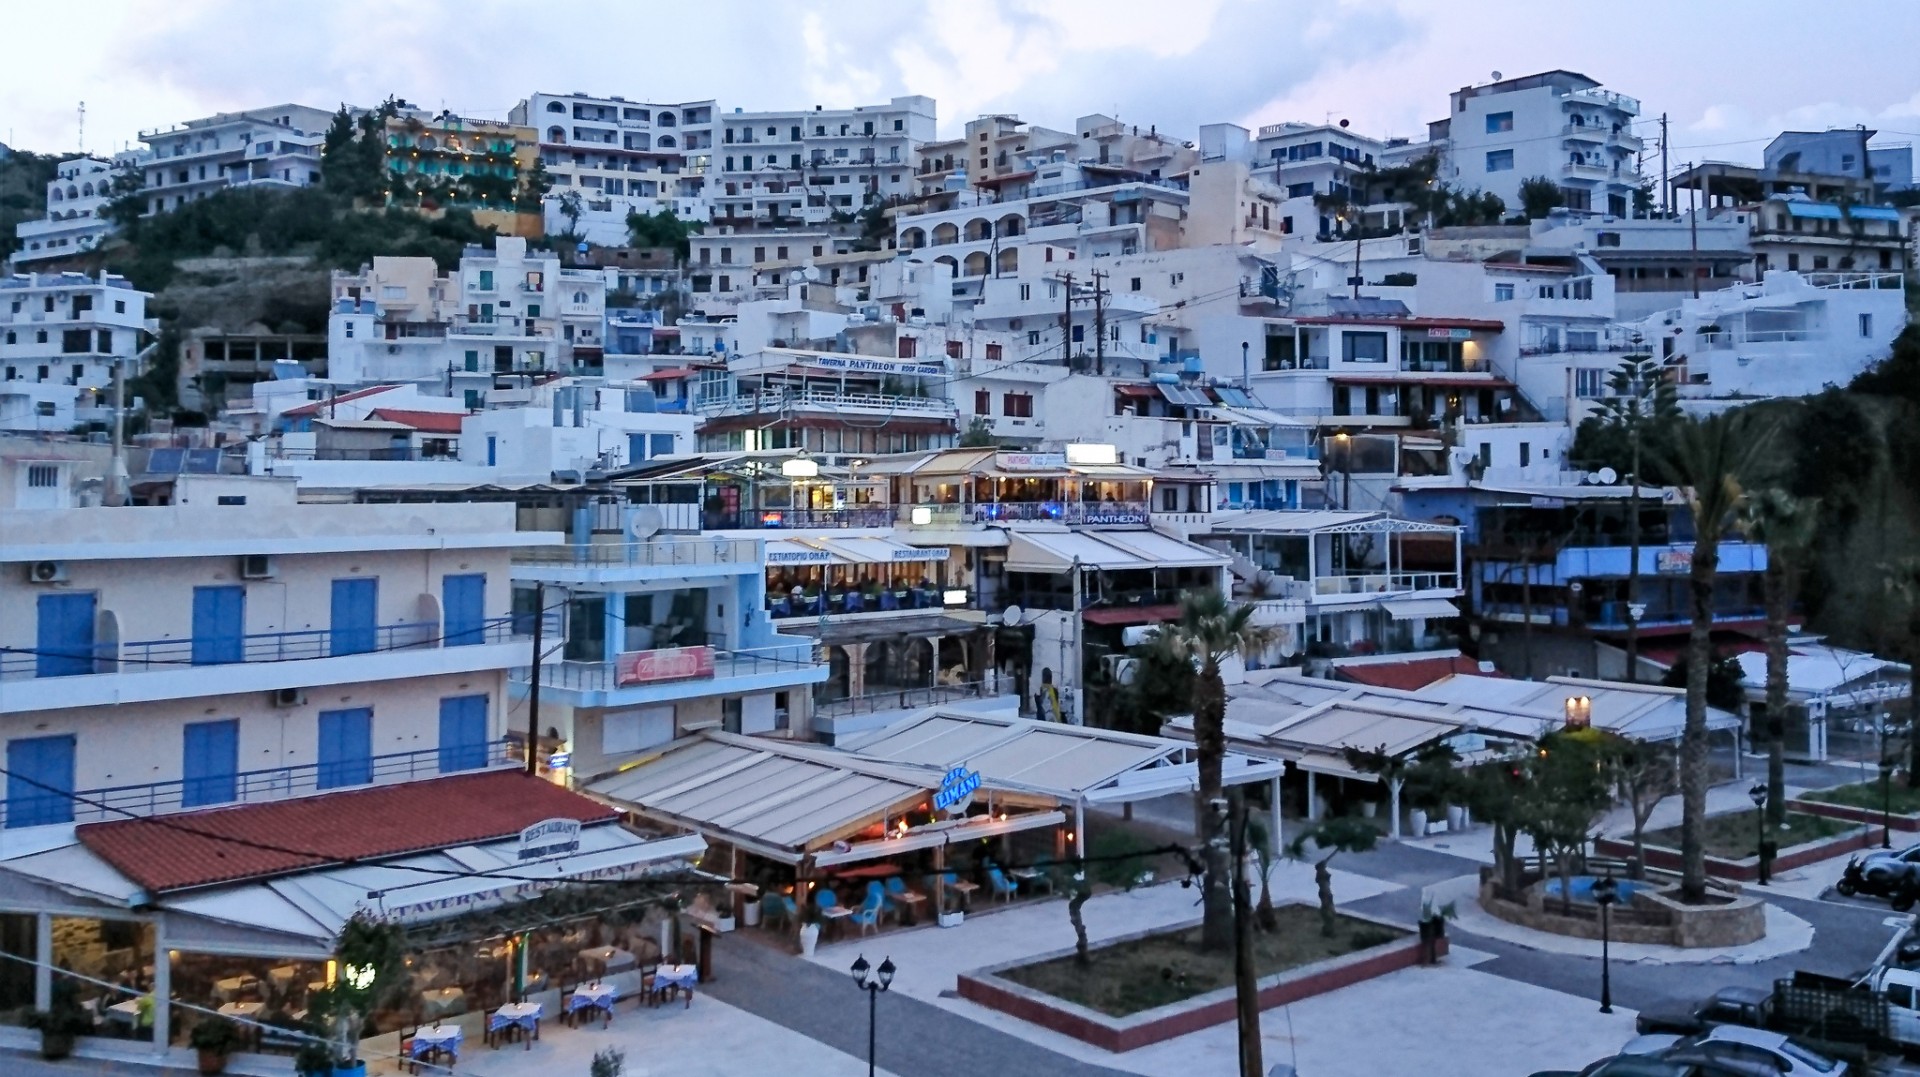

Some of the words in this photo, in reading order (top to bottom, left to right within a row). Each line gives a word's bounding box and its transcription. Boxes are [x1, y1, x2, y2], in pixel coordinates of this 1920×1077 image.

[818, 357, 846, 368] TAVERNA
[849, 360, 896, 372] PANTHEON
[901, 365, 916, 373] ROOF
[917, 366, 938, 375] GARDEN
[1086, 515, 1145, 524] PANTHEON
[936, 773, 980, 809] LIMANI
[524, 821, 578, 843] RESTAURANT
[394, 889, 501, 916] TAVERNA
[515, 862, 640, 894] RESAURANT
